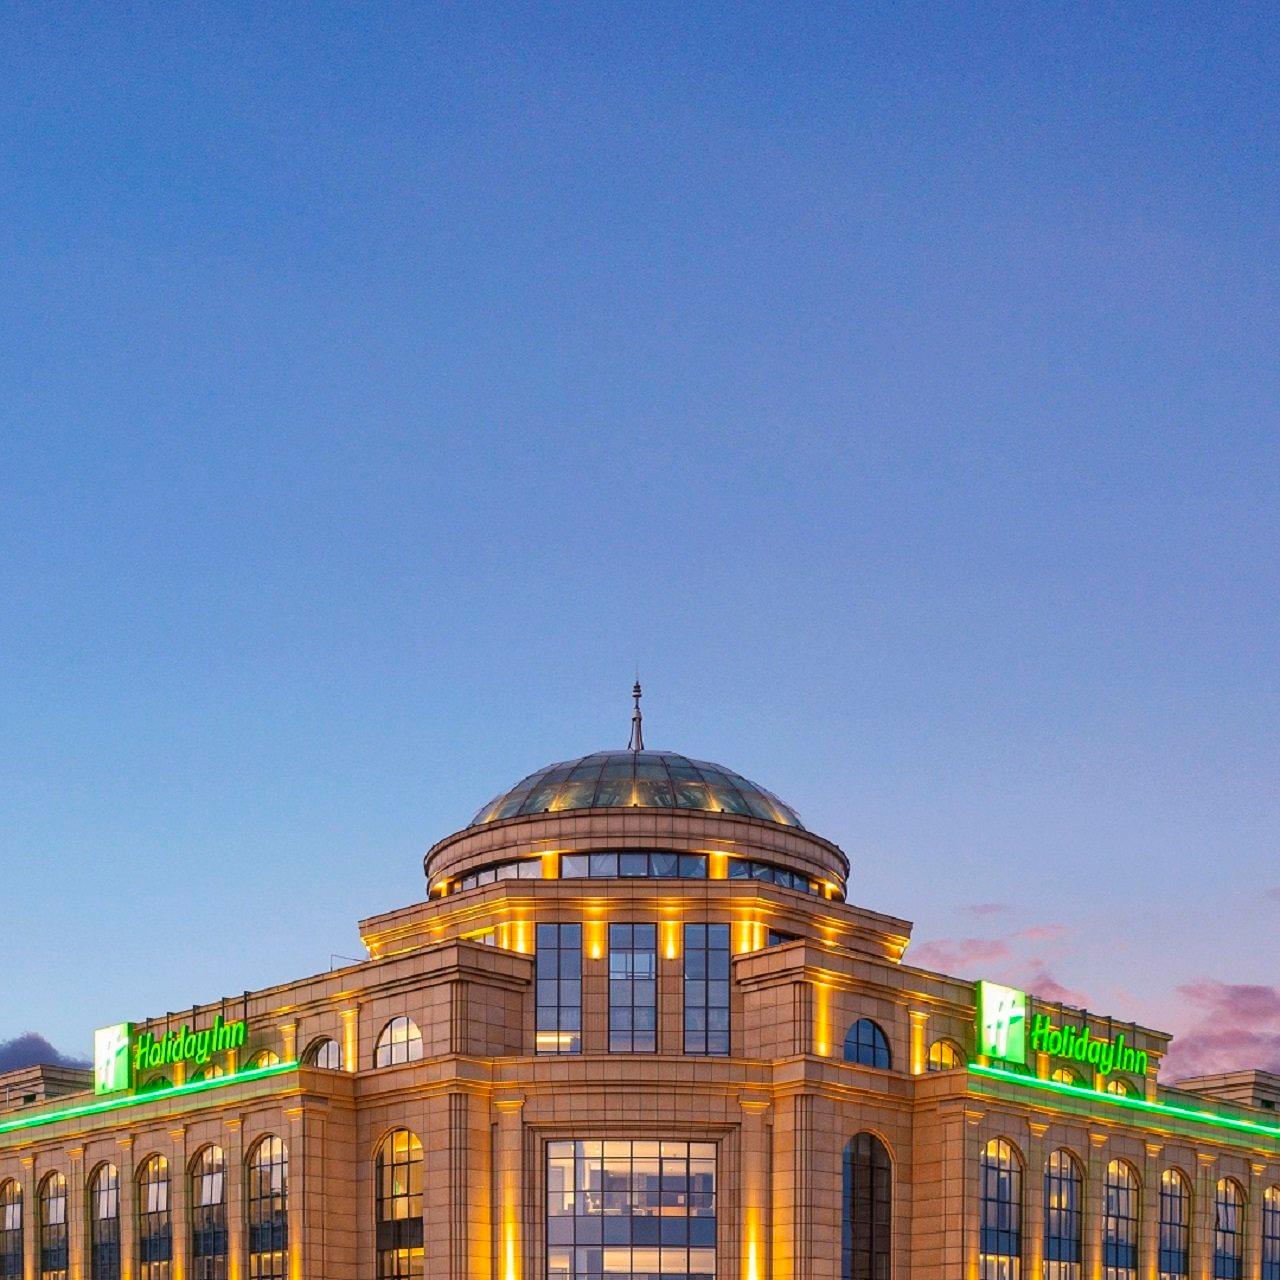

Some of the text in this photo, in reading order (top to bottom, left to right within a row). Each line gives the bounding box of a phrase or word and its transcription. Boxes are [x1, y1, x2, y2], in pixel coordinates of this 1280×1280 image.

[136, 1015, 248, 1070] Holiday Inn
[1030, 1013, 1148, 1076] Holiday Inn
